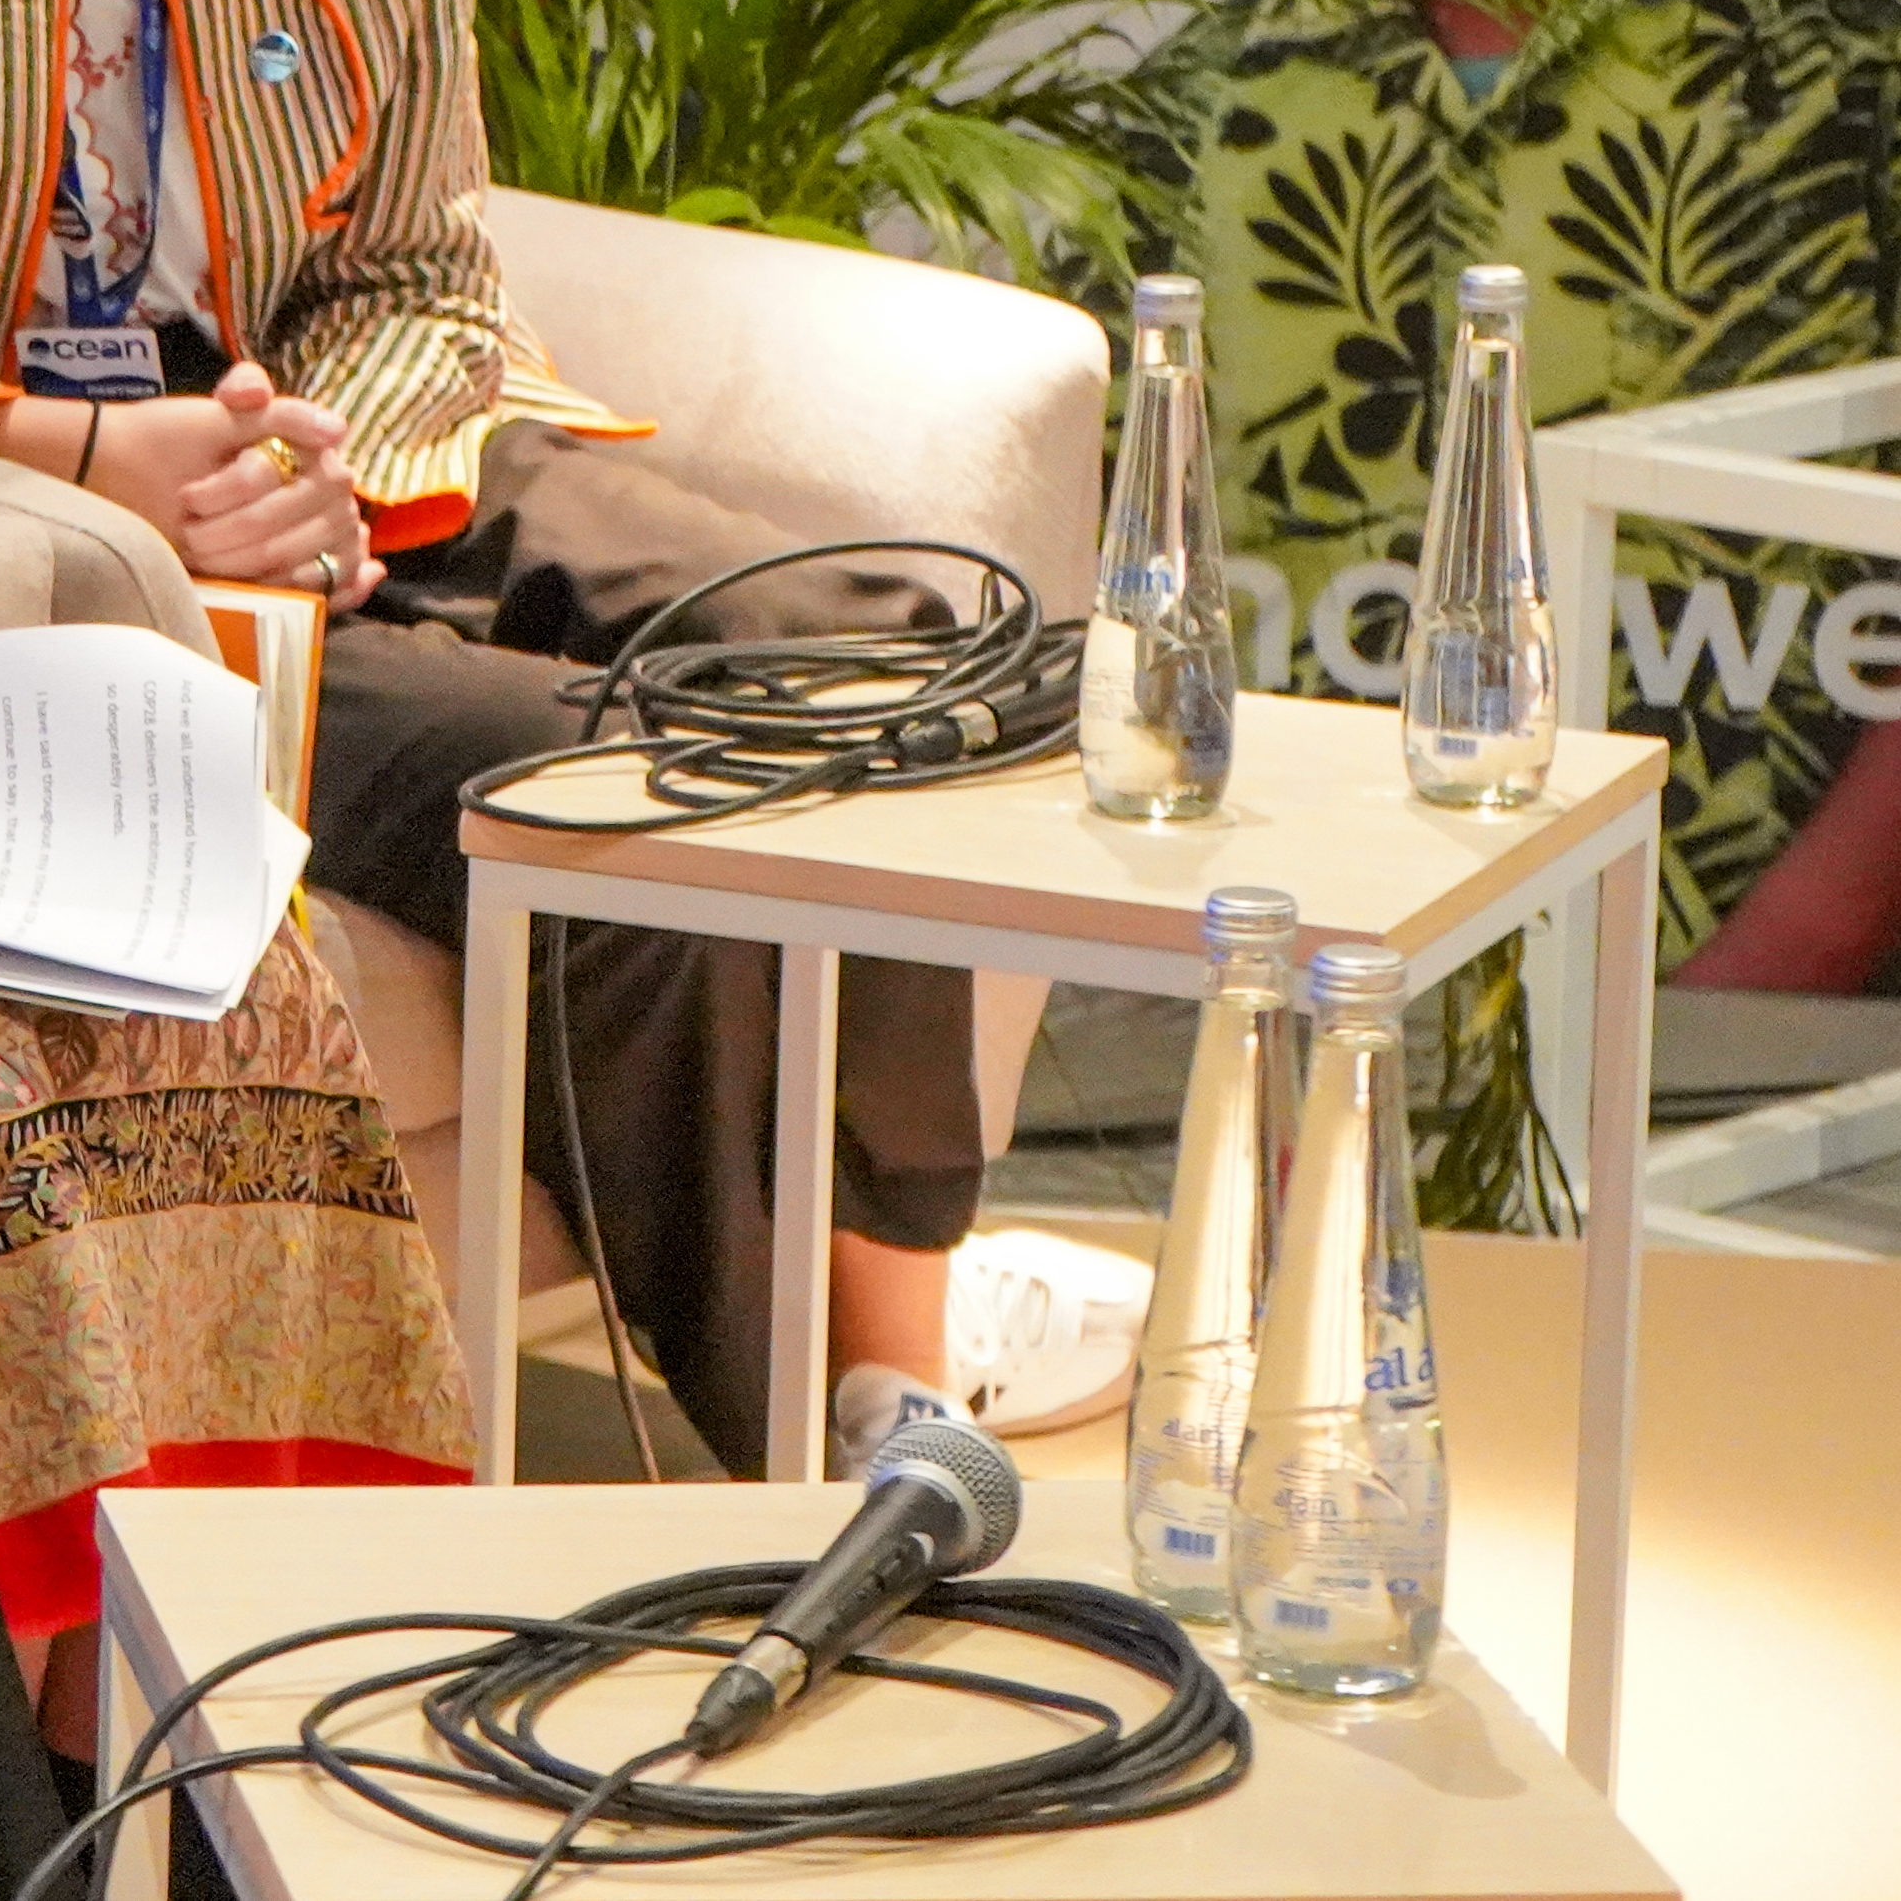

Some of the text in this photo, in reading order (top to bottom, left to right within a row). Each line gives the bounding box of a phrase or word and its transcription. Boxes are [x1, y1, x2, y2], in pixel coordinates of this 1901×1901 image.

[1, 696, 18, 758] continue
[36, 700, 50, 735] have
[106, 702, 124, 789] desperately
[5, 763, 19, 780] to
[182, 754, 197, 837] understand
